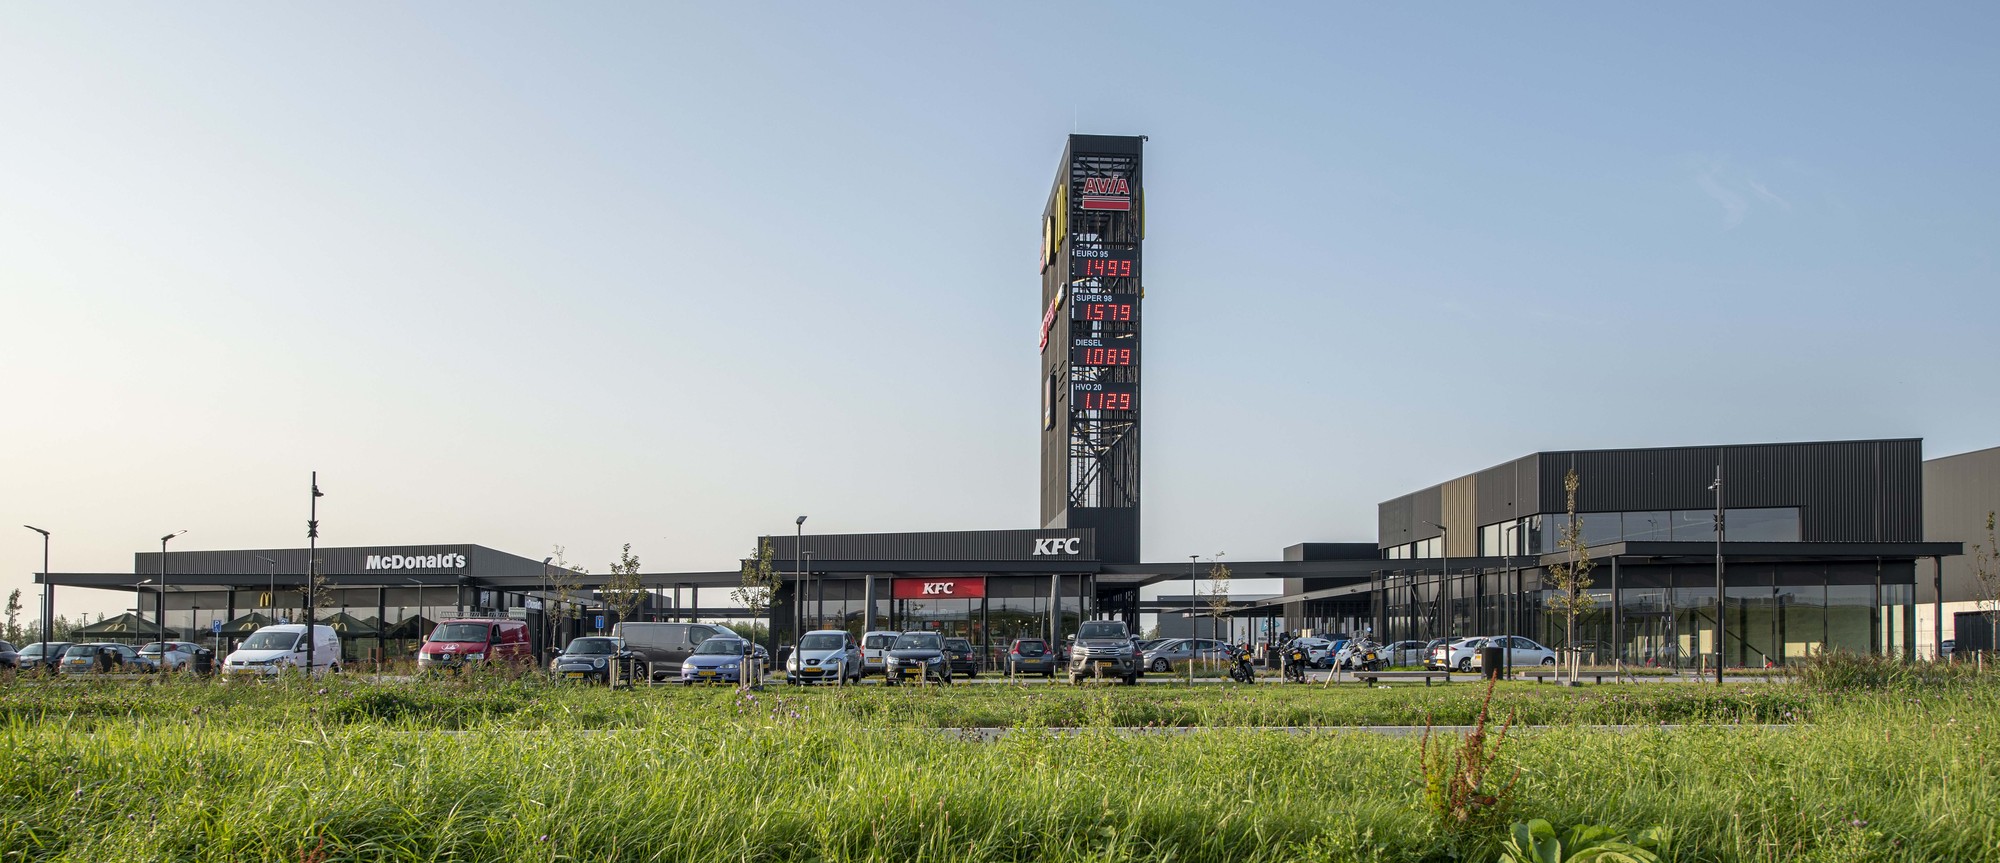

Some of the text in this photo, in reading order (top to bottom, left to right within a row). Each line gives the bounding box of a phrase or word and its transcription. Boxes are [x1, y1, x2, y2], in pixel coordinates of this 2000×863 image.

[1087, 259, 1131, 277] 1.499
[1086, 304, 1131, 320] 1.579
[1075, 339, 1103, 347] DIESEL
[1086, 348, 1130, 365] 1.089
[1085, 393, 1130, 410] 1.129
[1032, 537, 1080, 556] KFC
[366, 553, 466, 570] McDonald's
[922, 582, 954, 595] KFC
